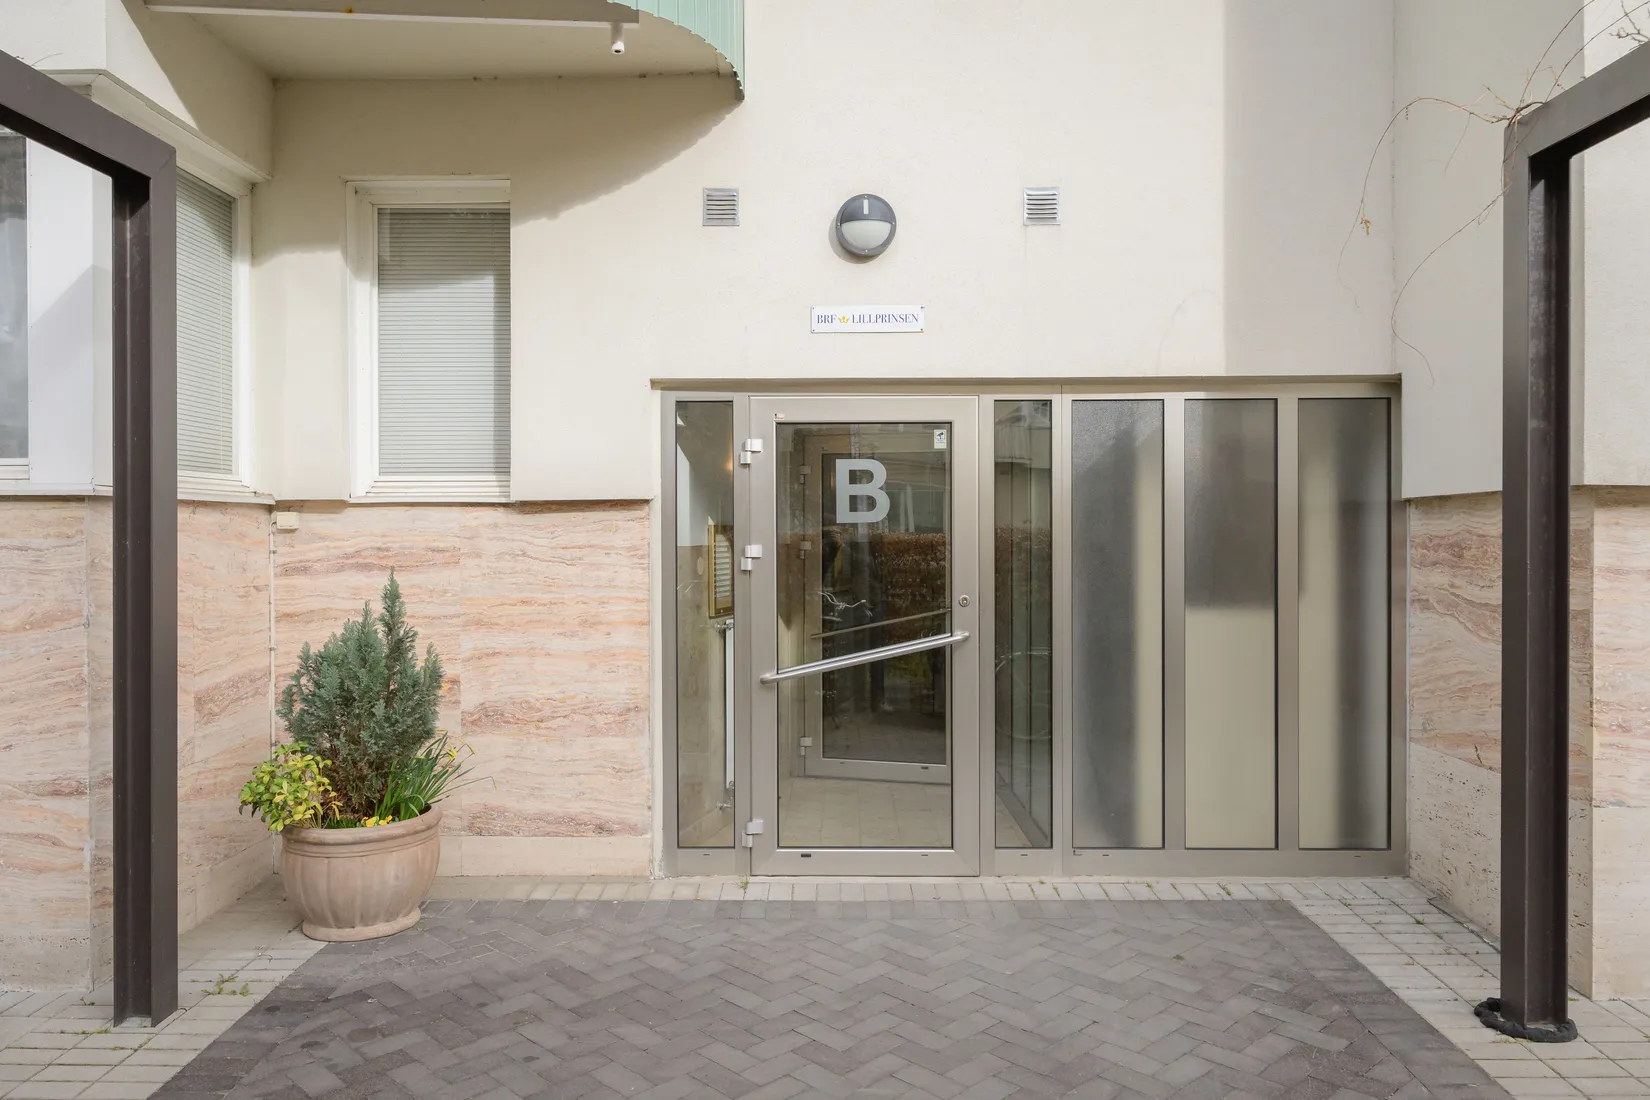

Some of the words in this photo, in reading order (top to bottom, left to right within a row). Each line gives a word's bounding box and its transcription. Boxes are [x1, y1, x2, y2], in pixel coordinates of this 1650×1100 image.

[817, 314, 836, 324] BRF
[852, 314, 919, 324] LILLPRINSEN
[835, 458, 890, 523] B
